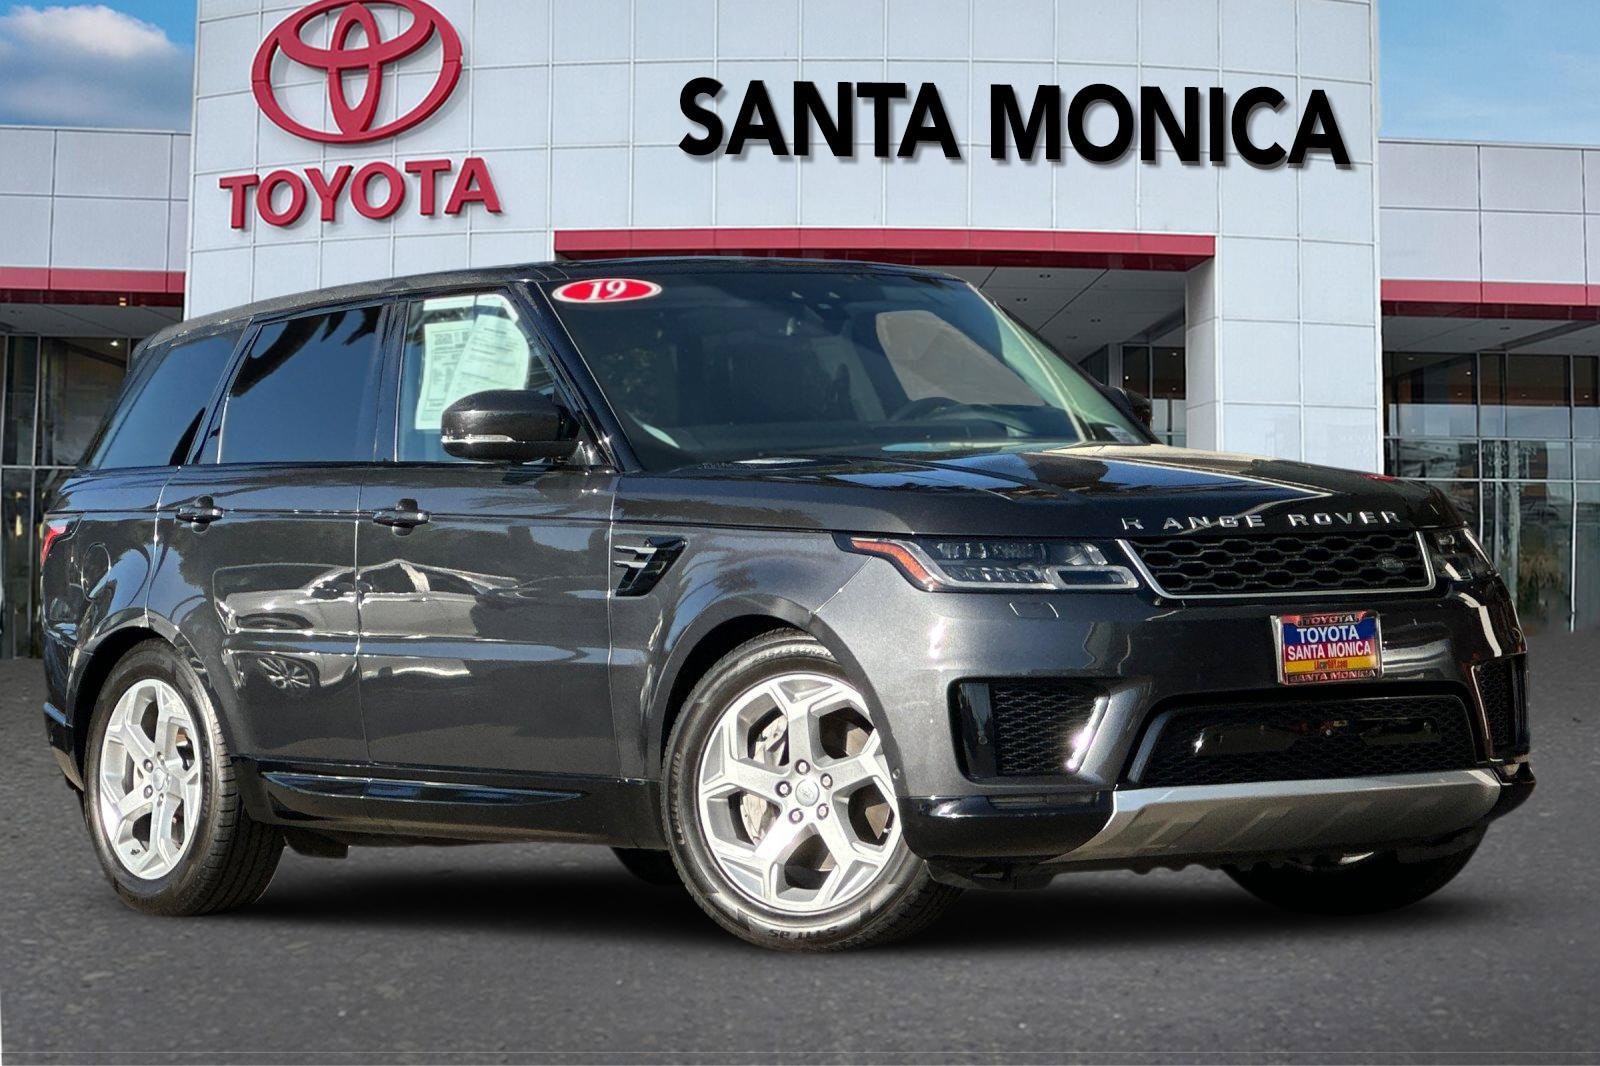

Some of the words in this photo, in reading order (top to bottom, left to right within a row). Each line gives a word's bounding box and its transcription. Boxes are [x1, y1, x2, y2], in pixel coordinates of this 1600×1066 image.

[679, 76, 961, 159] SANTA
[990, 82, 1351, 170] MONICA
[219, 157, 503, 230] TOYOTA
[589, 280, 627, 301] 19
[1121, 515, 1266, 531] RANGE
[1288, 511, 1400, 527] ROVER
[1303, 614, 1354, 625] TOYOTA
[1297, 625, 1360, 643] TOYOTA
[1288, 644, 1325, 661] SANTA
[1327, 641, 1371, 657] MONICA
